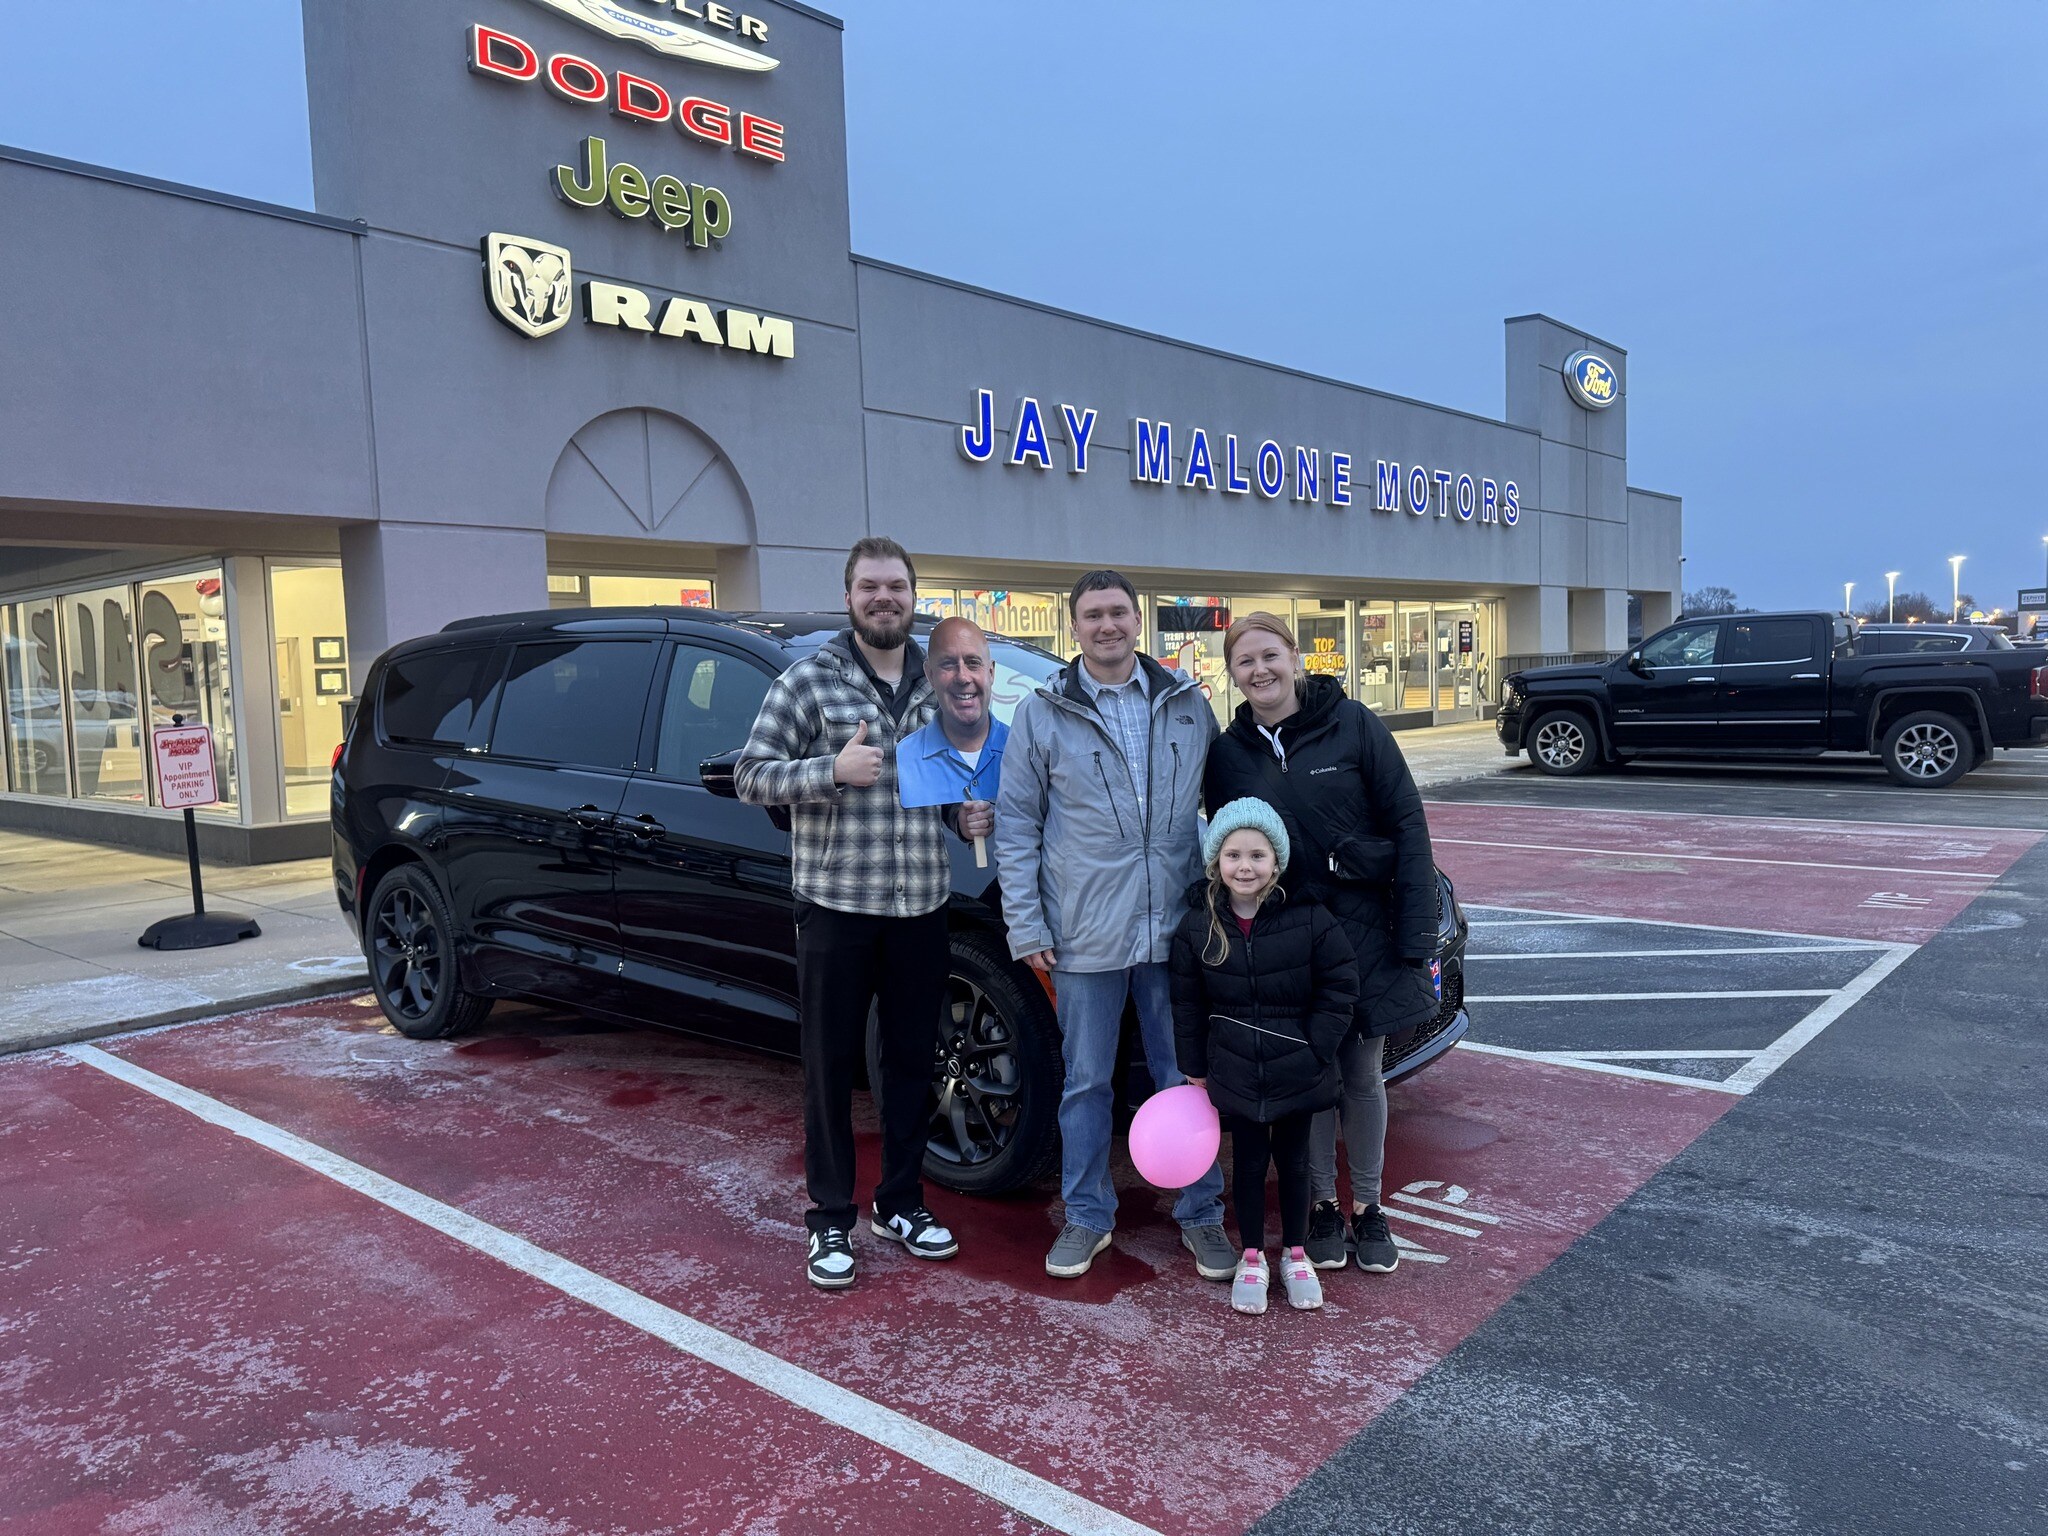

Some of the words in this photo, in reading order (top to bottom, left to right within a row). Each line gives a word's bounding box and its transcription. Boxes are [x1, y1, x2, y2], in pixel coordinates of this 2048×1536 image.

[608, 11, 668, 36] CHRYSLER
[646, 0, 769, 43] LER
[472, 22, 786, 163] DODGE
[555, 135, 732, 248] Jeep
[588, 280, 796, 359] RAM
[1584, 362, 1612, 398] Ford
[961, 387, 1098, 474] JAY
[1131, 417, 1352, 506] MALONE
[1373, 459, 1521, 527] MOTORS
[1313, 637, 1336, 653] TOP
[1304, 654, 1345, 670] DOLLAR
[163, 769, 210, 782] Appointment
[178, 762, 193, 771] VIP
[1315, 766, 1338, 774] Columbia
[171, 780, 204, 790] PARKING
[179, 790, 199, 799] ONLY
